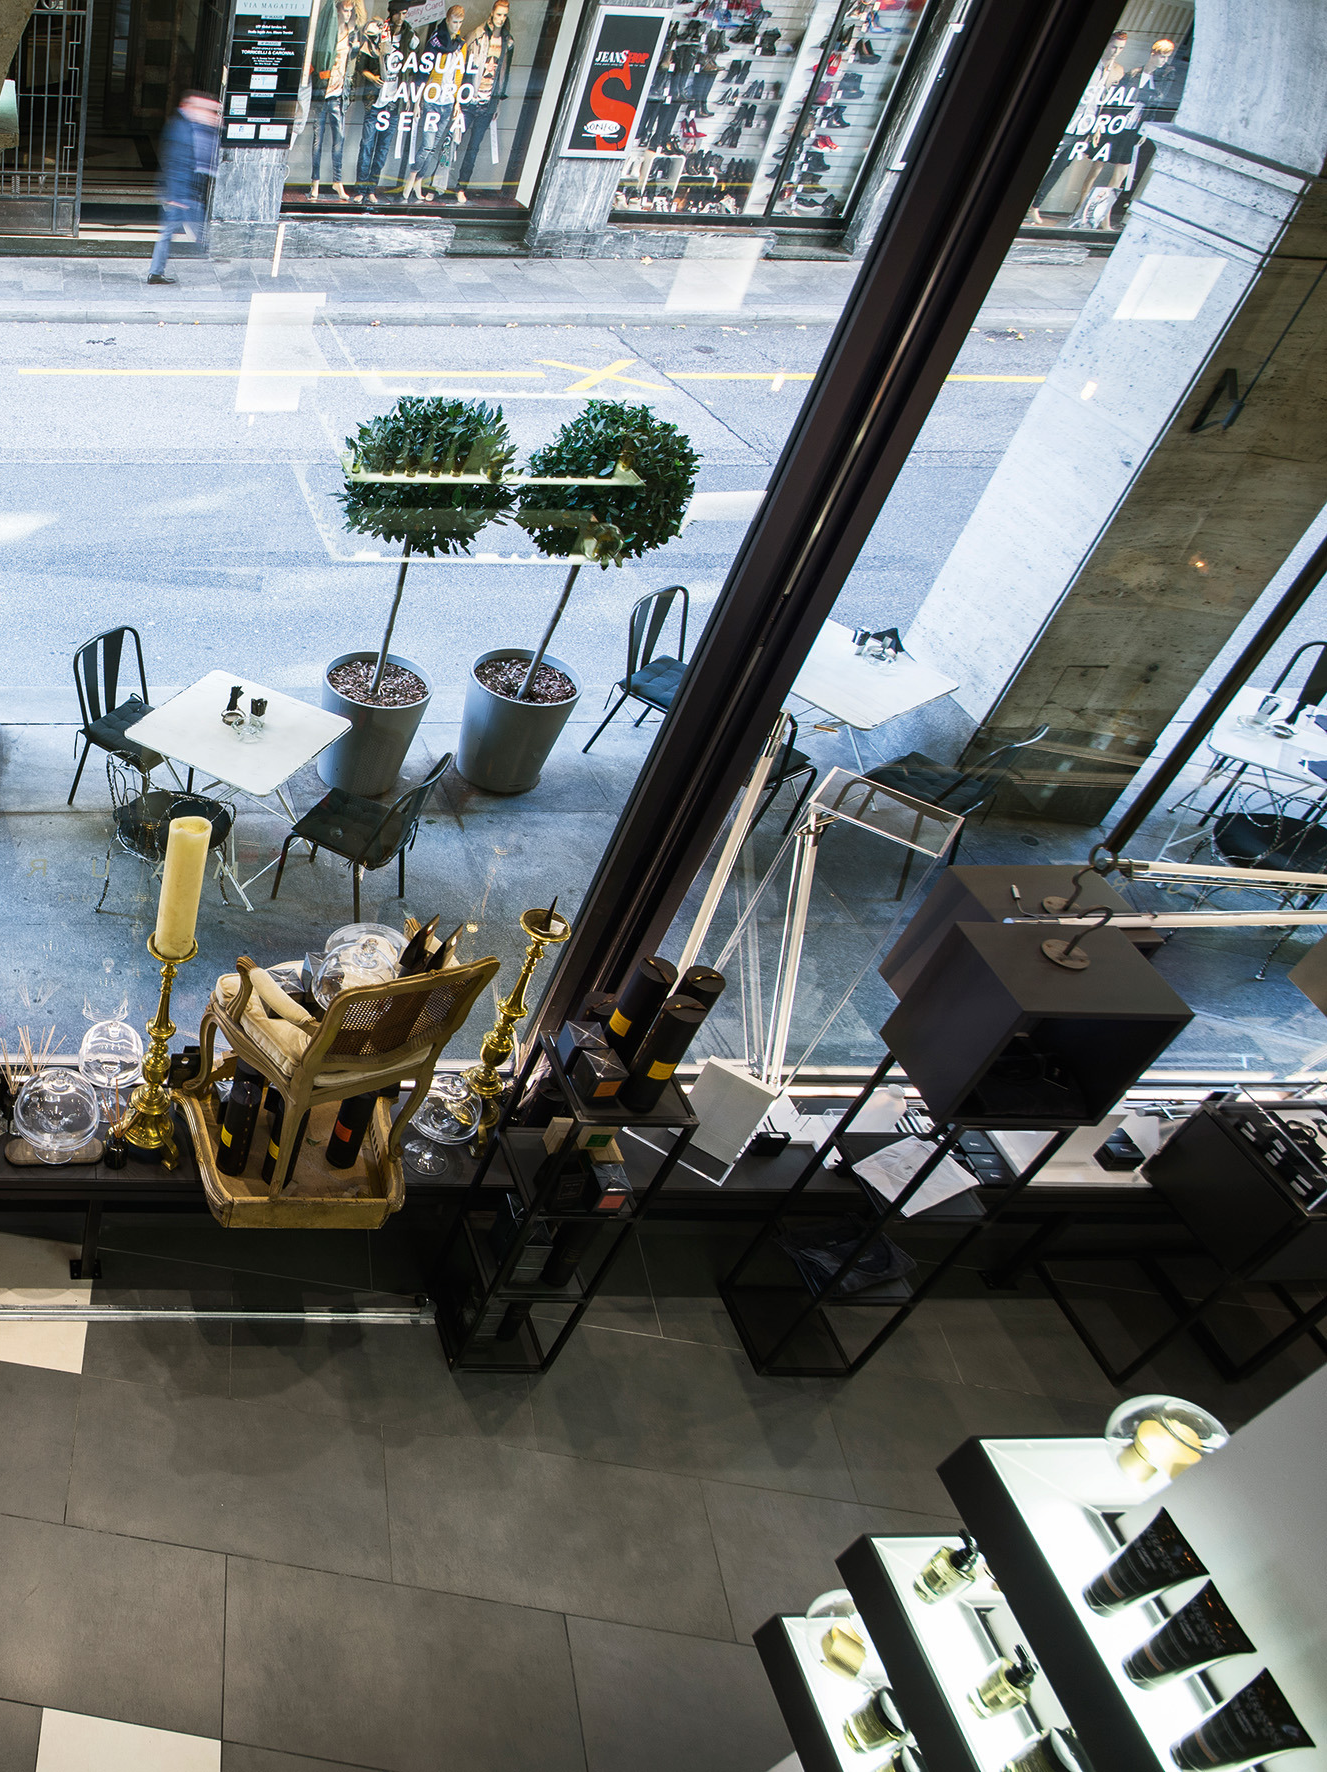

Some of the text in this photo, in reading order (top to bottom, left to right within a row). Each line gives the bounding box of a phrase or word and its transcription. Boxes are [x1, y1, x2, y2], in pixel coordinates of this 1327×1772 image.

[387, 51, 479, 75] CASUAL
[381, 81, 474, 104] LAVORO
[1079, 86, 1137, 107] SUAL
[375, 110, 466, 133] SERA
